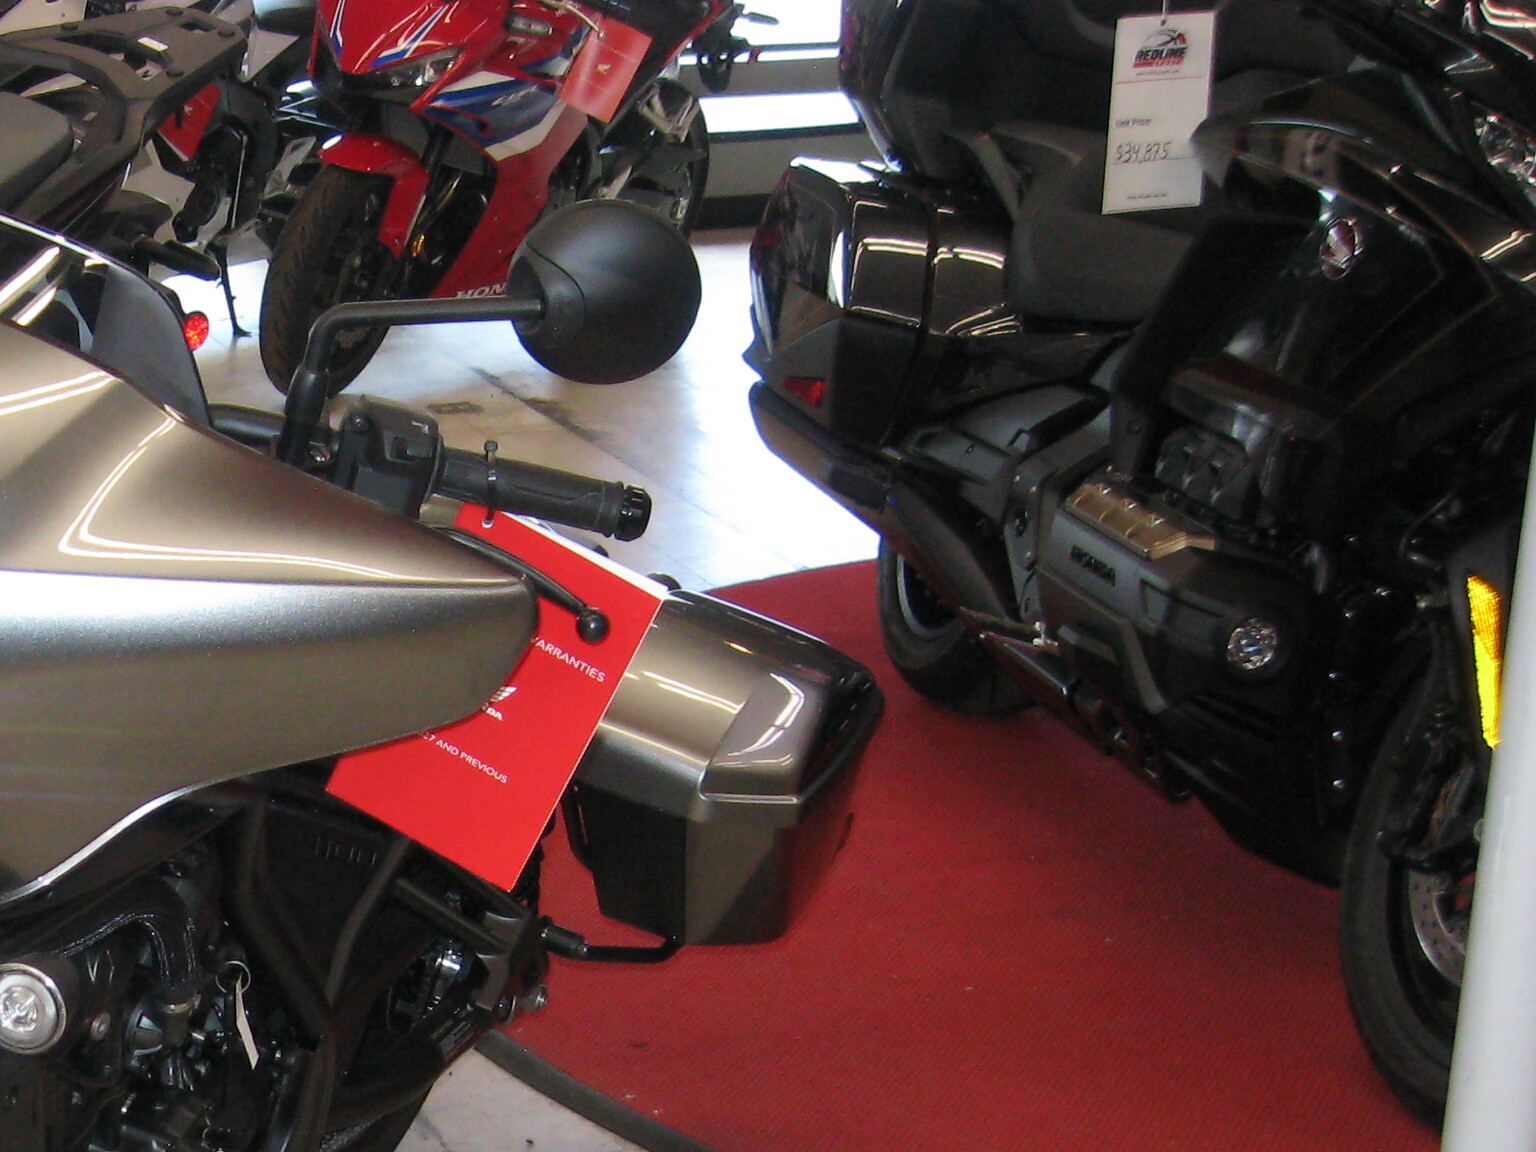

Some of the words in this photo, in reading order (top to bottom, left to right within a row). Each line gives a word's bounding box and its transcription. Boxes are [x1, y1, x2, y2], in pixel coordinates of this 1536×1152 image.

[456, 281, 508, 298] HON
[434, 739, 460, 756] AND
[459, 751, 509, 784] PREVIOUS
